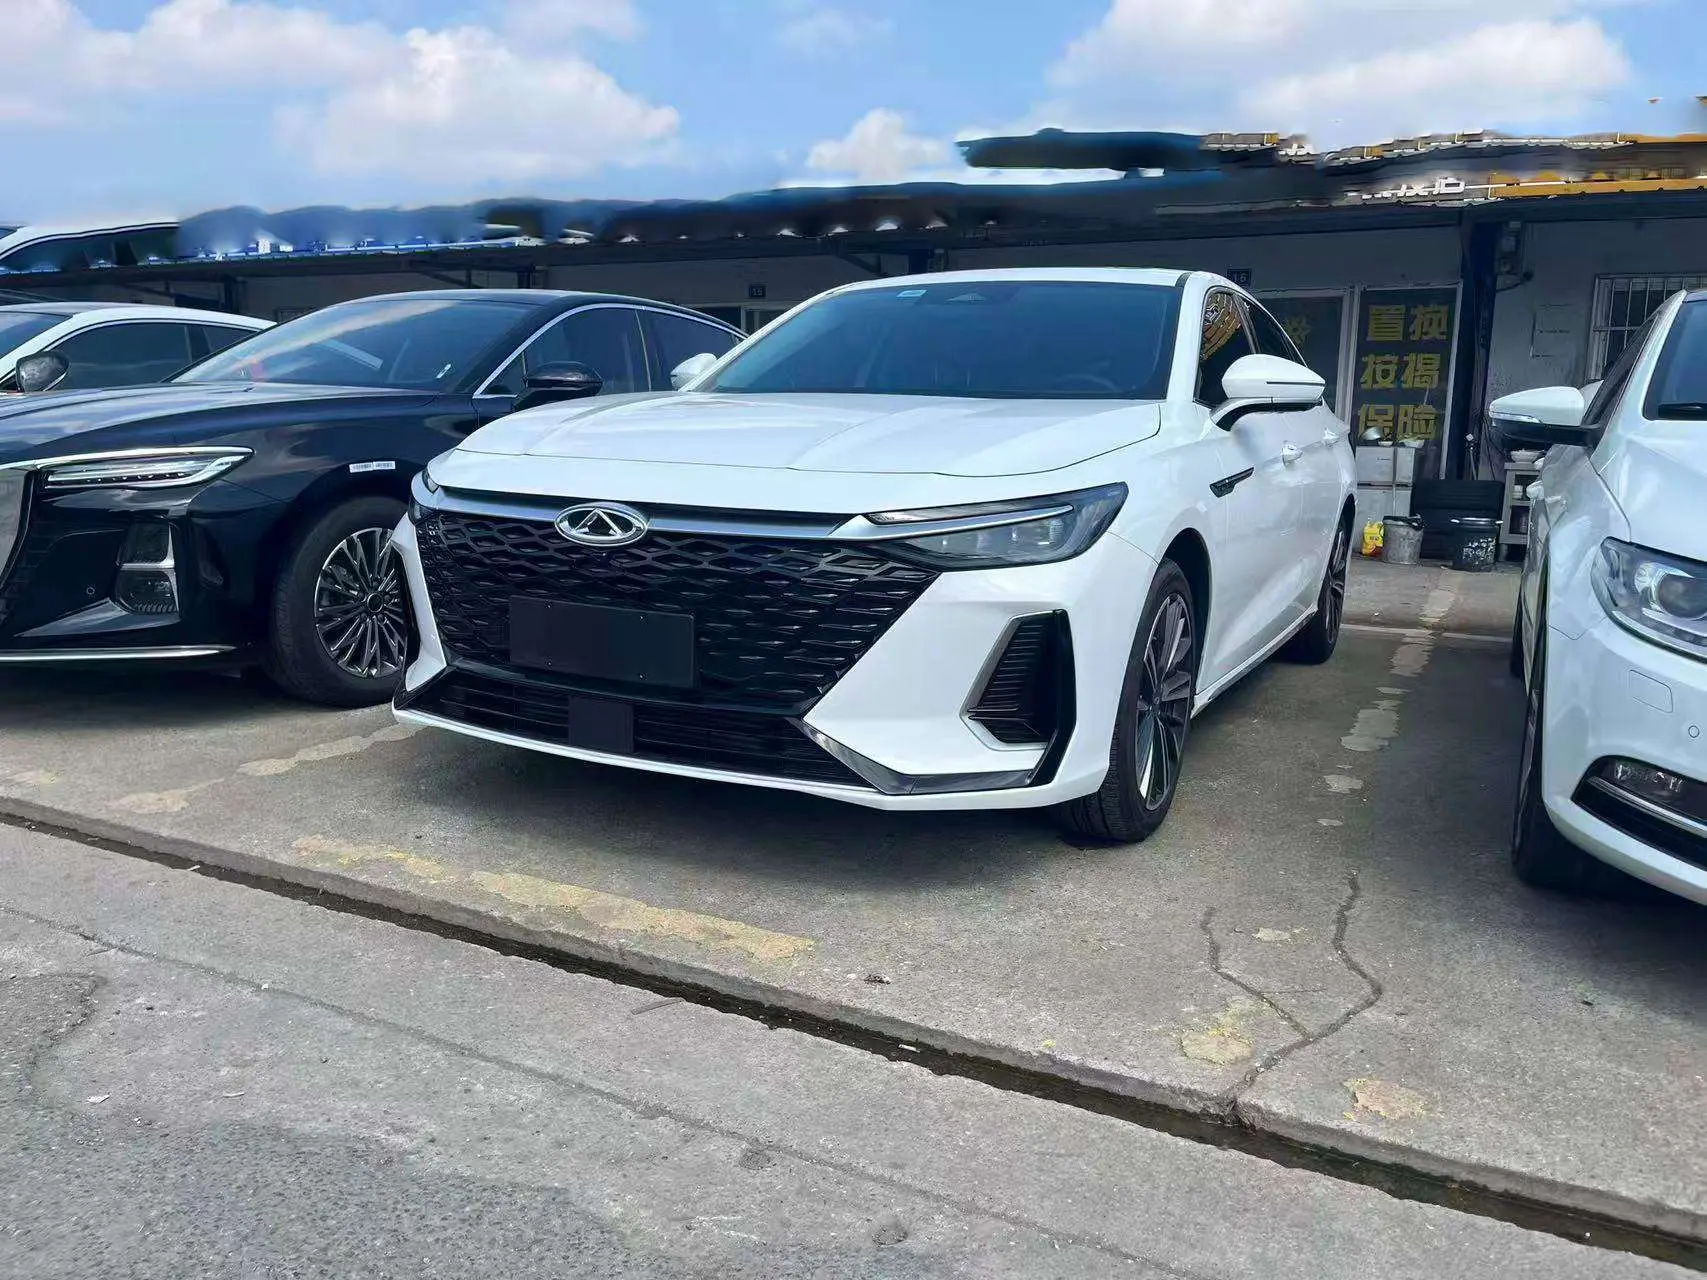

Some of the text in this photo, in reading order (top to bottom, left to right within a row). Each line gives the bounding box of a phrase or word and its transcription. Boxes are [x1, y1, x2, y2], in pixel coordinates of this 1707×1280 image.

[1366, 304, 1449, 341] 置换
[1360, 353, 1441, 389] 按揭
[1358, 403, 1437, 440] 保险
